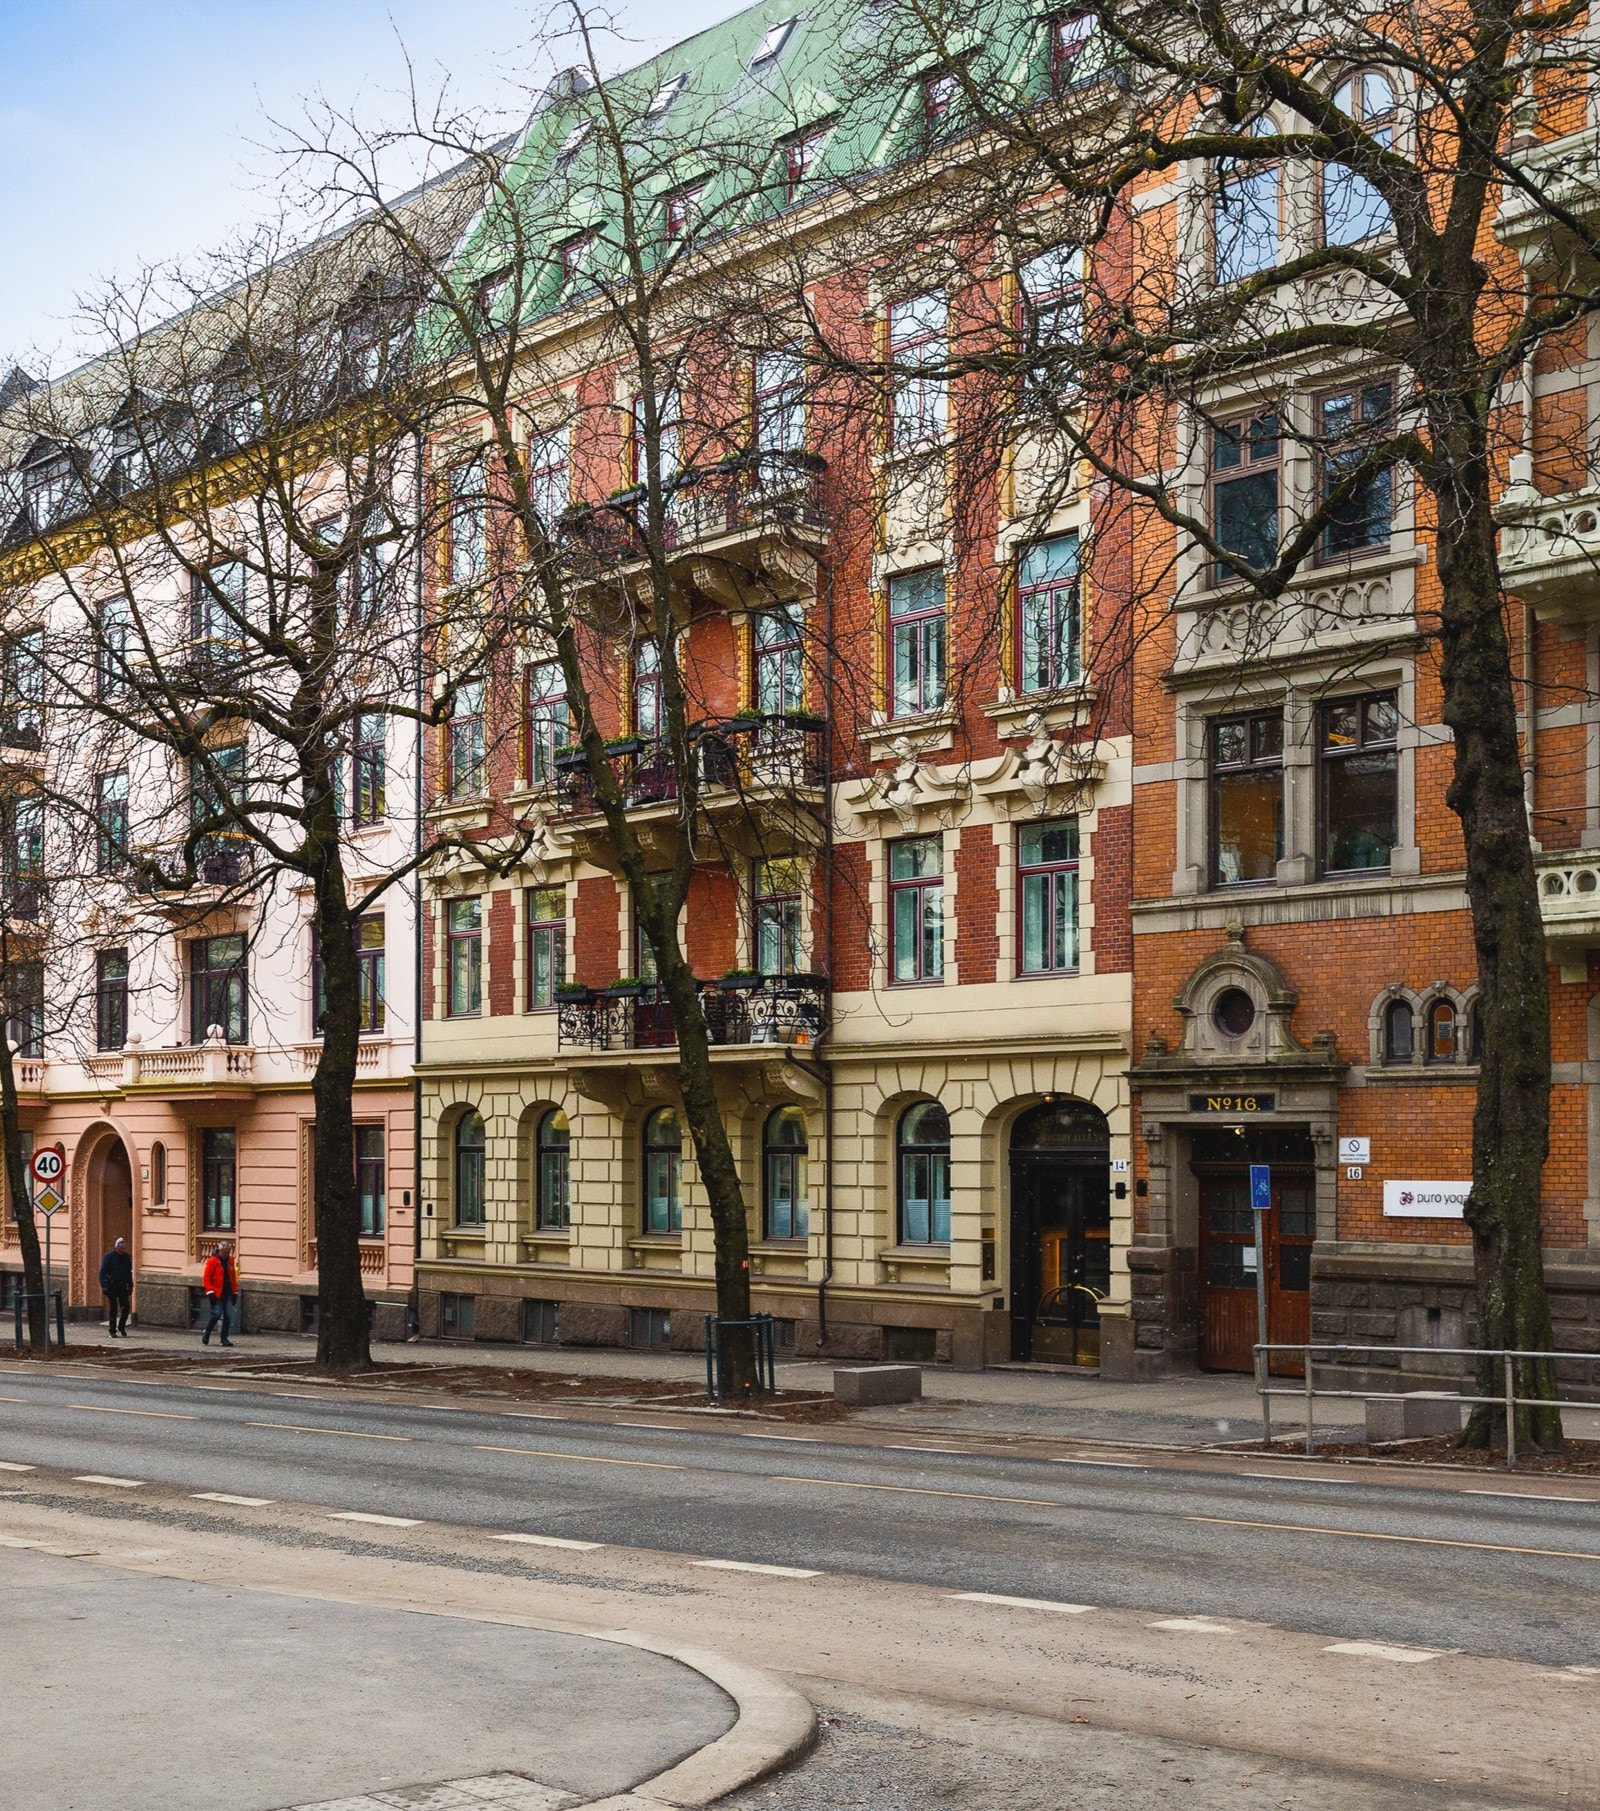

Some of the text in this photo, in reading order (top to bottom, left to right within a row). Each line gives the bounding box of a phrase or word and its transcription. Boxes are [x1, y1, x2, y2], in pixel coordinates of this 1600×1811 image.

[37, 1156, 60, 1173] 40
[1115, 1161, 1124, 1171] 14
[1349, 1168, 1360, 1179] 16
[1417, 1193, 1442, 1204] puro
